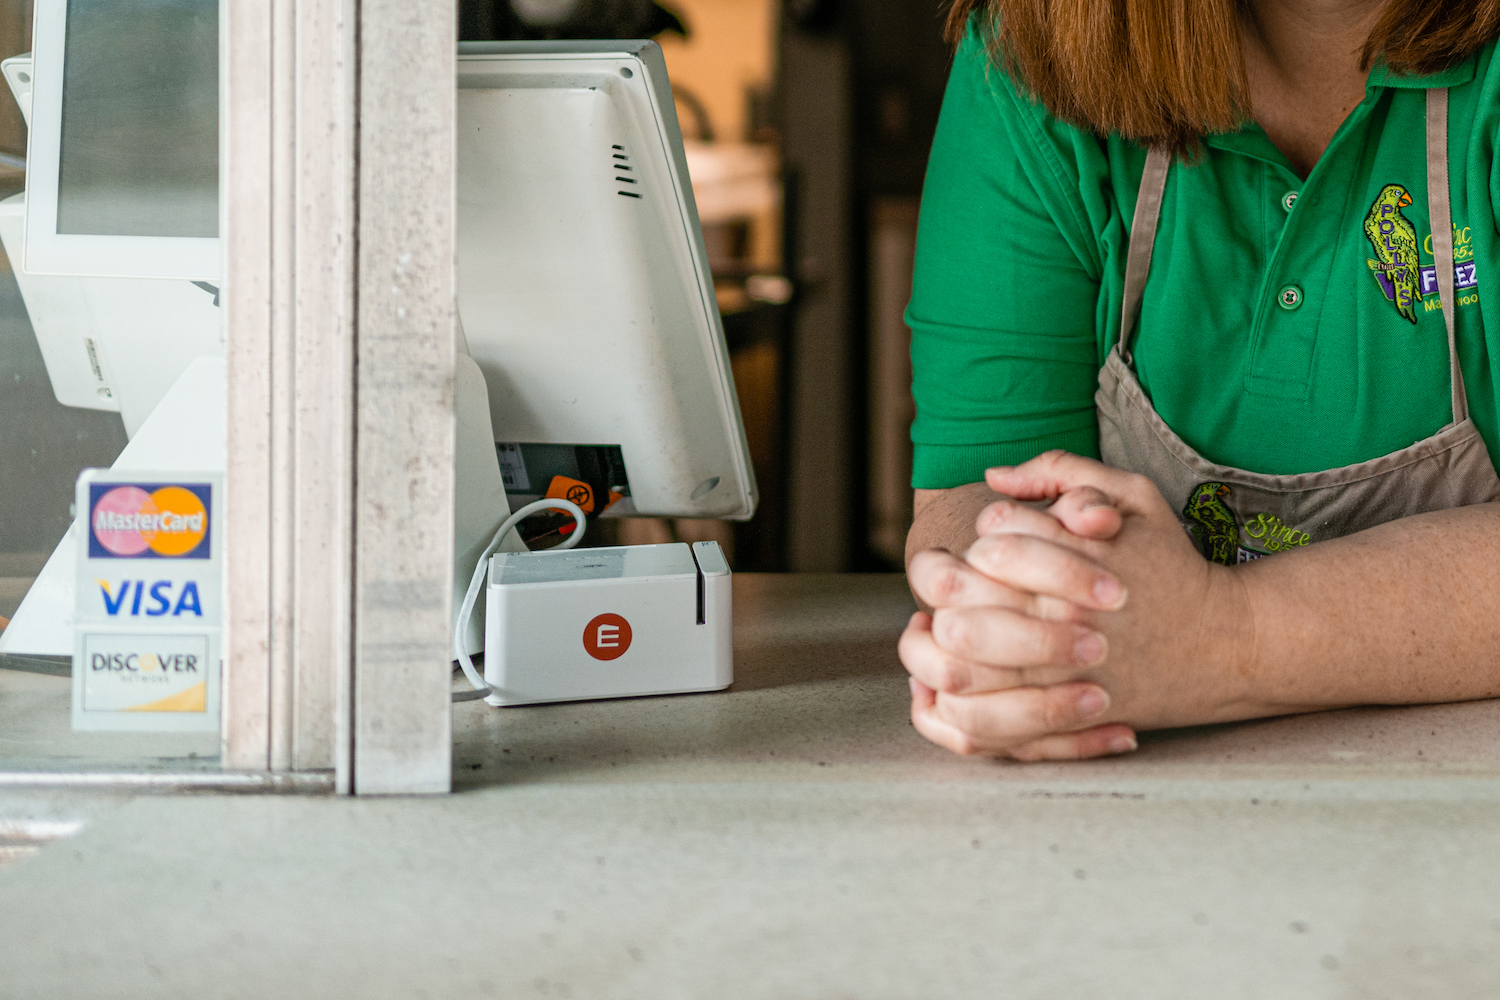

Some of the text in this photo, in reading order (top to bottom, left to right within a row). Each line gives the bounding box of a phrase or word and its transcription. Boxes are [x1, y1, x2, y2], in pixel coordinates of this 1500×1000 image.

[1379, 203, 1411, 306] POLLY'S
[97, 510, 202, 532] MasterCard
[1244, 512, 1310, 546] Since
[97, 578, 203, 616] VISA
[91, 653, 198, 672] DISCOVER
